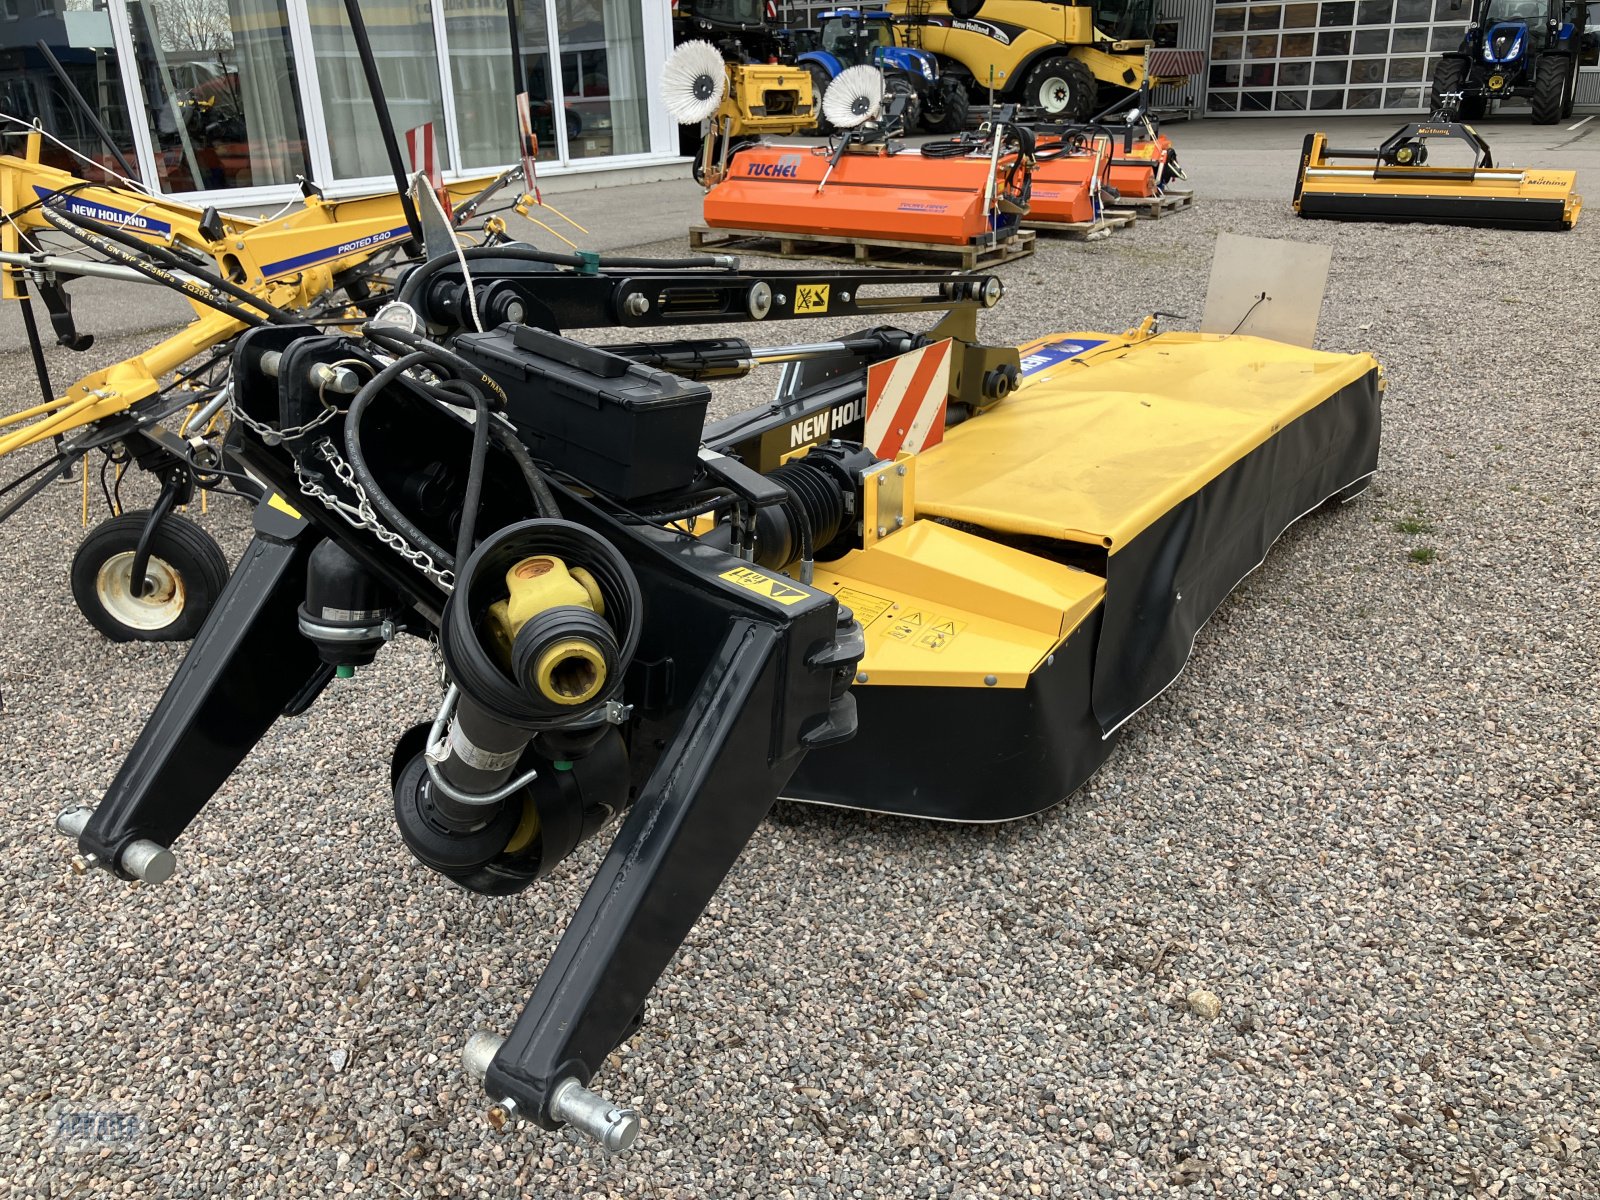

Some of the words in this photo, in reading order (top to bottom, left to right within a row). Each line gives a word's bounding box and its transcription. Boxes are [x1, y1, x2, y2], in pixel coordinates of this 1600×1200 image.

[952, 19, 966, 29] New
[966, 22, 989, 36] Holland
[747, 163, 798, 178] TUCHEL
[71, 203, 96, 217] NEW
[98, 210, 148, 228] HOLLAND
[337, 237, 372, 255] PROTED
[372, 231, 391, 244] 540
[182, 281, 214, 301] 2Q2020
[790, 411, 830, 448] NEW
